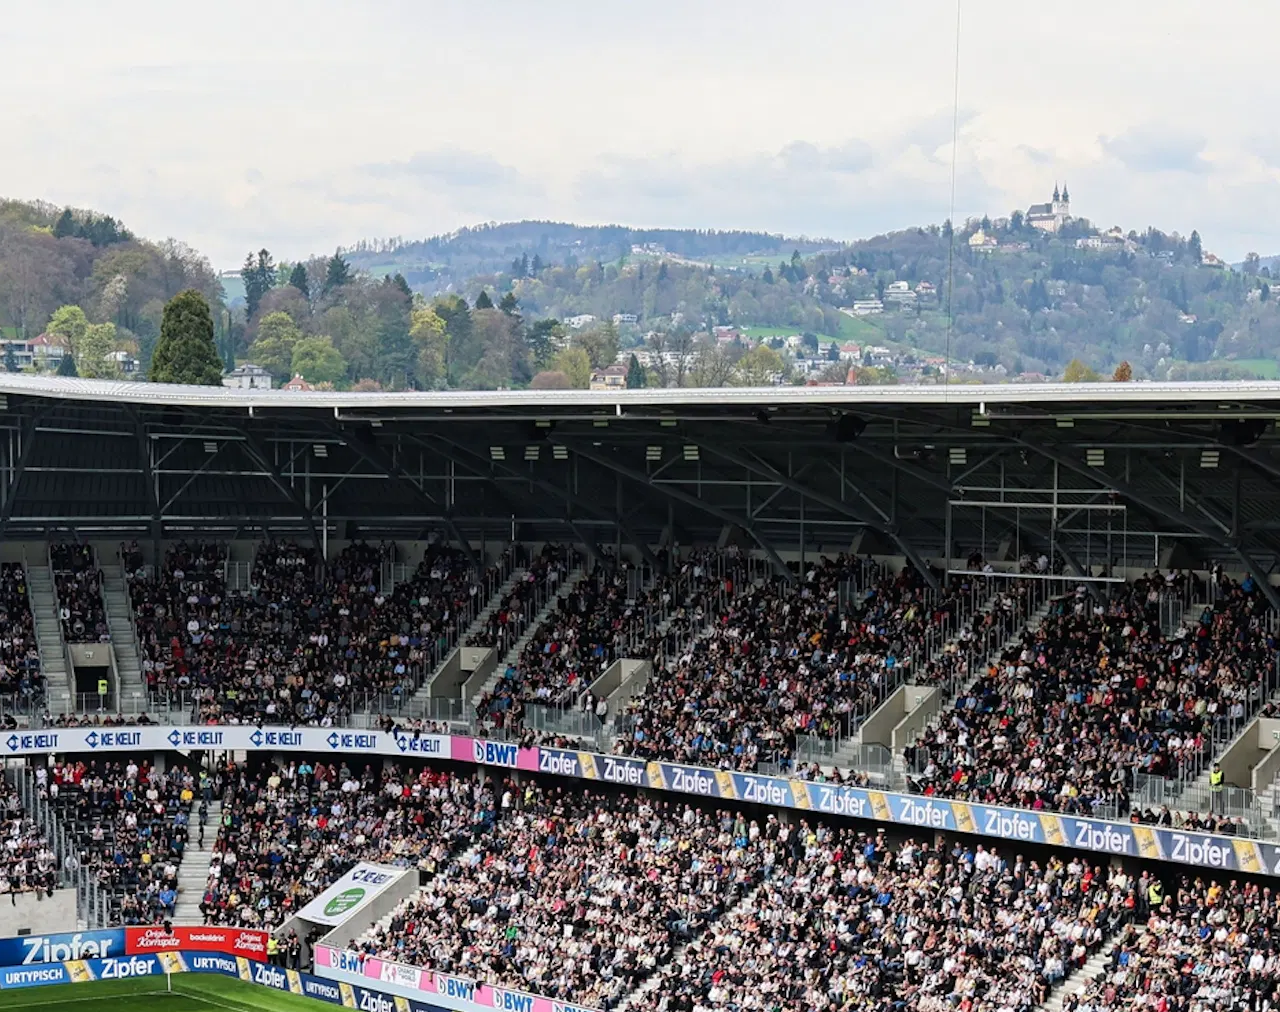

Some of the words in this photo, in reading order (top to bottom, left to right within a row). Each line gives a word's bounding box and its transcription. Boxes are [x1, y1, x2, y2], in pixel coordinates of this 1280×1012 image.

[21, 734, 32, 748] KE
[34, 734, 58, 748] KELIT
[100, 733, 113, 746] KE
[115, 732, 141, 746] KELIT
[183, 732, 195, 745] KE
[197, 732, 223, 745] KELIT
[265, 733, 278, 746] KE
[280, 732, 302, 746] KELIT
[341, 734, 352, 748] KE
[354, 735, 376, 748] KELIT
[420, 739, 440, 752] KELIT
[486, 743, 517, 767] BWT
[540, 753, 578, 775] Zipfer
[604, 758, 643, 784] Zipfer
[672, 768, 713, 794] Zipfer
[743, 777, 787, 804] Zipfer
[820, 787, 865, 816] Zipfer
[900, 799, 949, 828] Zipfer
[985, 809, 1037, 840] Zipfer
[1075, 822, 1130, 853] Zipfer
[1172, 835, 1230, 867] Zipfer
[6, 968, 63, 985] URTYPISCH
[101, 956, 155, 978] Zipfer
[193, 957, 236, 974] URTYPISCH
[255, 963, 285, 987] Zipfer
[306, 979, 339, 1000] URTYPISCH
